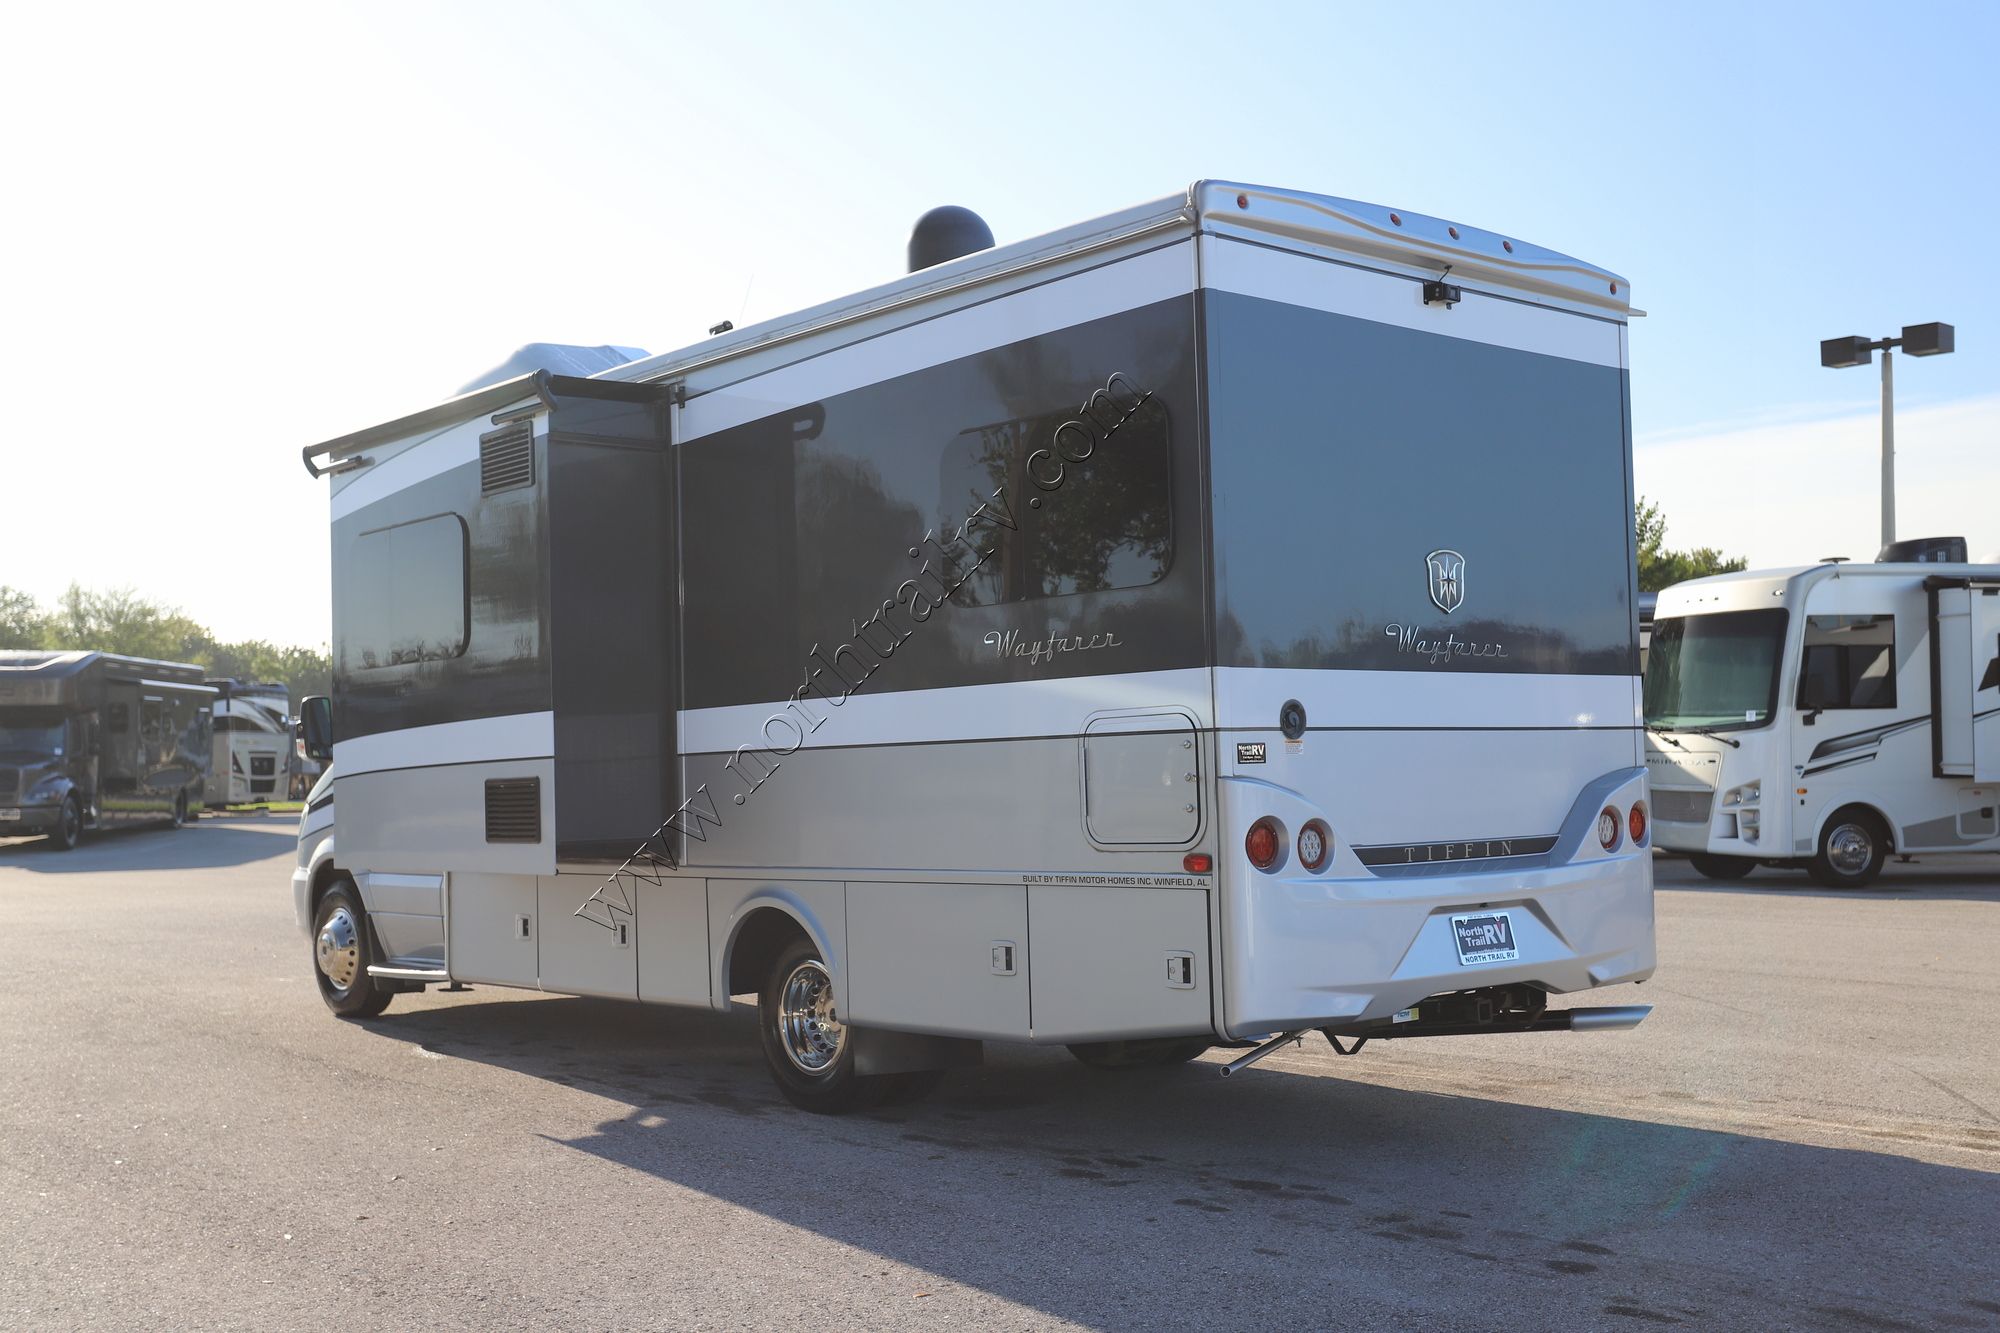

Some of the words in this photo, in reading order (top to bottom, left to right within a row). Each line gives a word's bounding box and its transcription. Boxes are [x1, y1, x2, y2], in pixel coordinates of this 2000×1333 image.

[983, 629, 1124, 665] Wayfarer
[1385, 623, 1509, 665] Wayfarer
[1251, 745, 1264, 755] RV
[1404, 841, 1512, 862] TIFFIN
[1022, 875, 1043, 883] BUILT
[1044, 875, 1053, 883] BY
[1055, 876, 1078, 884] TIFFIN
[1079, 876, 1106, 884] MOTOR
[1108, 877, 1135, 885] HOMES
[1154, 878, 1196, 887] WINFIELD,
[1458, 926, 1483, 937] North
[1465, 937, 1486, 946] Trail
[1483, 924, 1505, 944] RV
[1465, 954, 1487, 963] NORTH
[1488, 952, 1506, 960] TRAIL
[1506, 951, 1515, 959] RV
